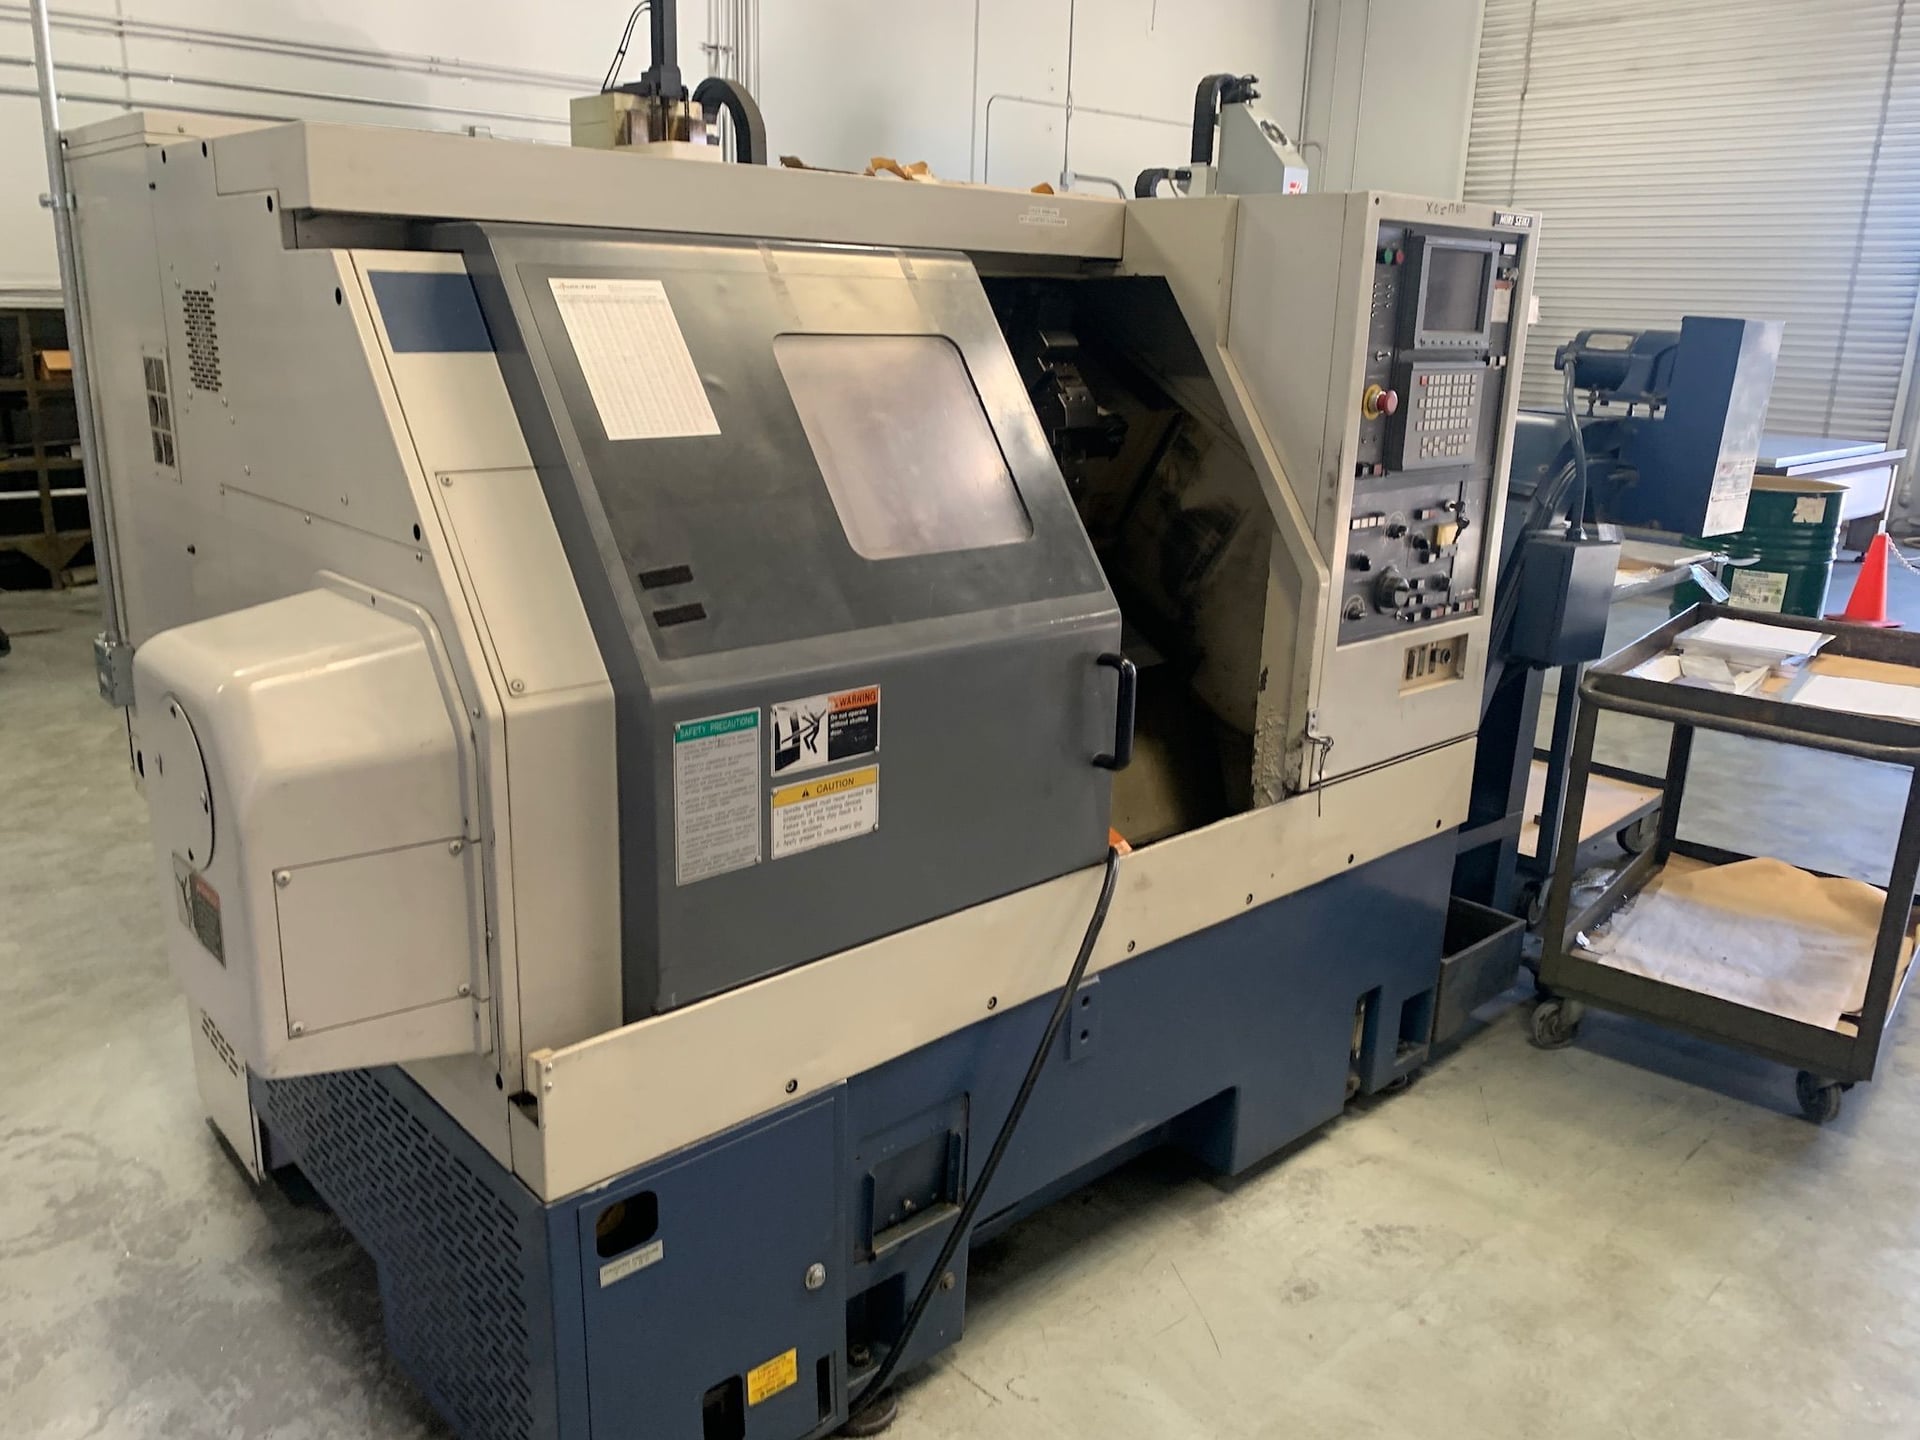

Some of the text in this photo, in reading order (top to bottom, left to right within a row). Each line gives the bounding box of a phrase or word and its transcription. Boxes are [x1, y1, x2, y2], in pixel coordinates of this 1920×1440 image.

[839, 691, 876, 707] WARNING
[680, 714, 754, 737] SAFETY PRECAUTIONS
[816, 777, 854, 793] CAUTION
